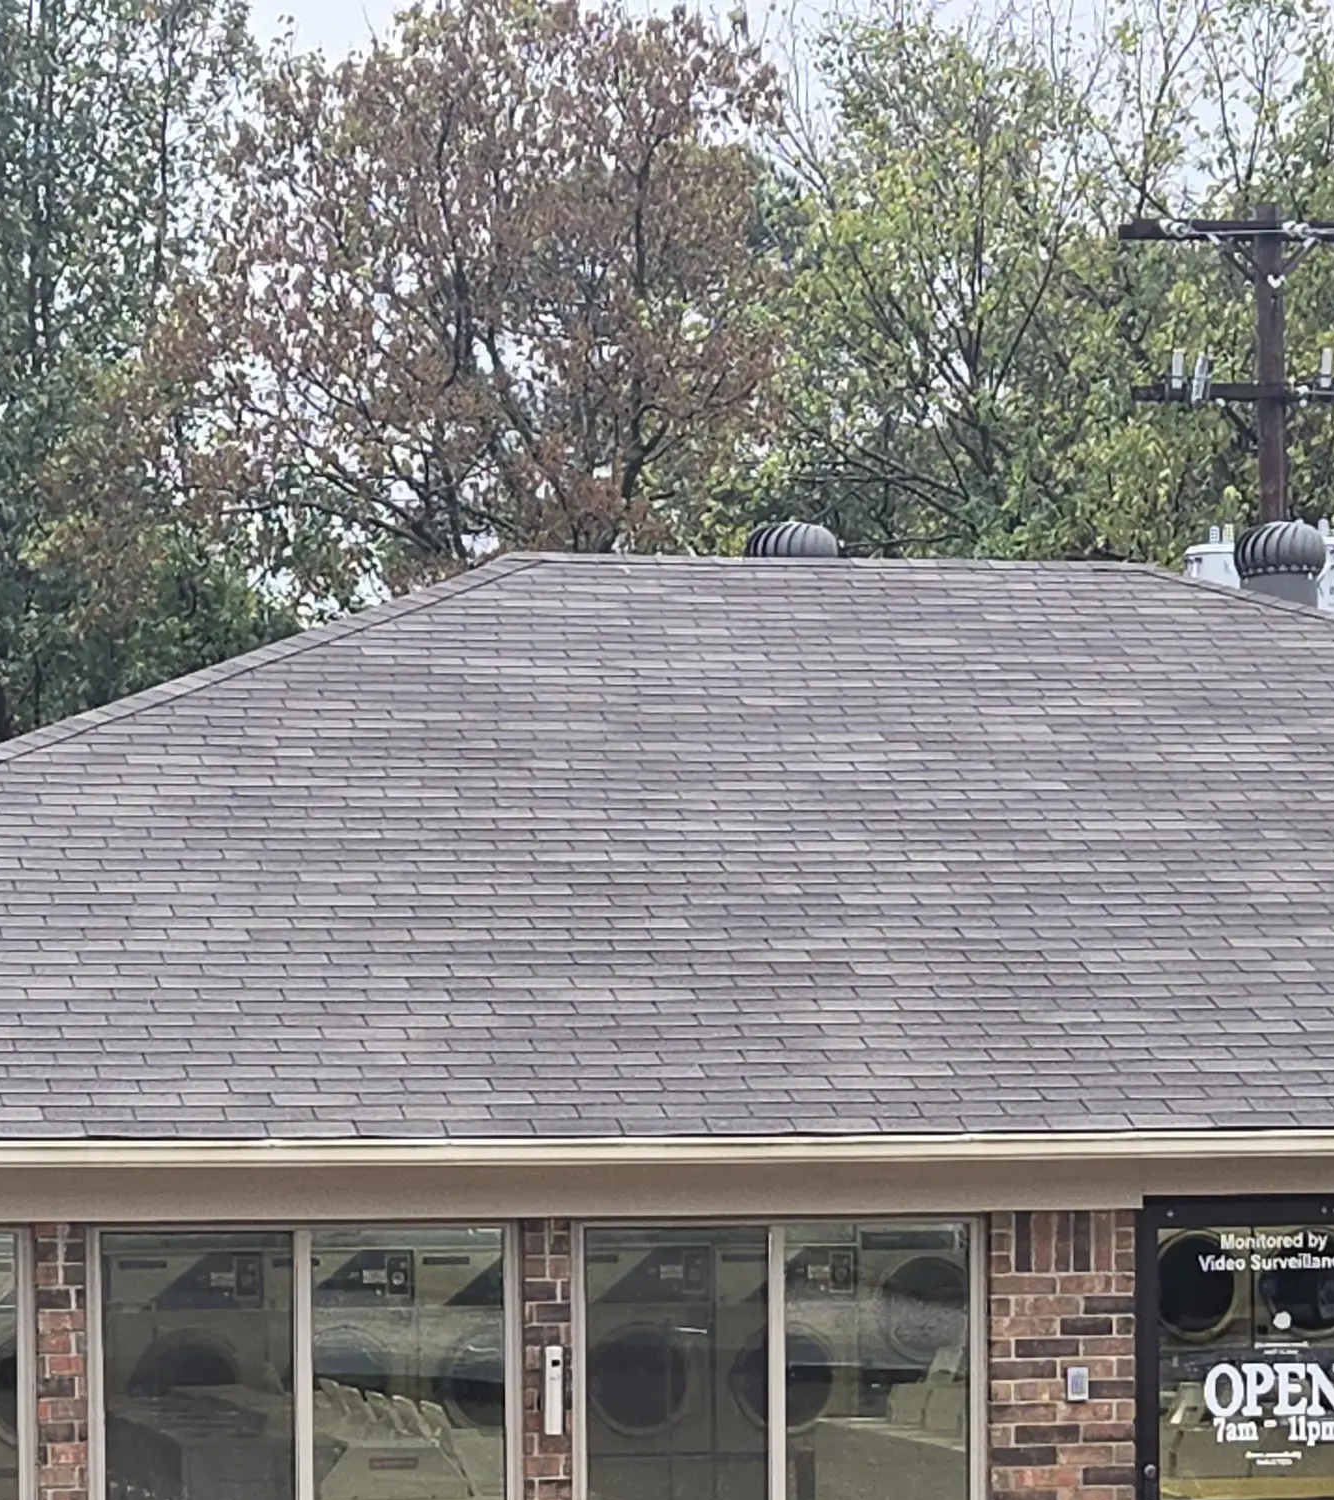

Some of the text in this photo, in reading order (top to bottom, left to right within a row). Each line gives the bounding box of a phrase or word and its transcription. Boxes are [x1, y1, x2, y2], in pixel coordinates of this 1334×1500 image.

[1220, 1231, 1328, 1253] Monitored by
[1199, 1255, 1247, 1272] Video
[1213, 1416, 1259, 1443] 7am
